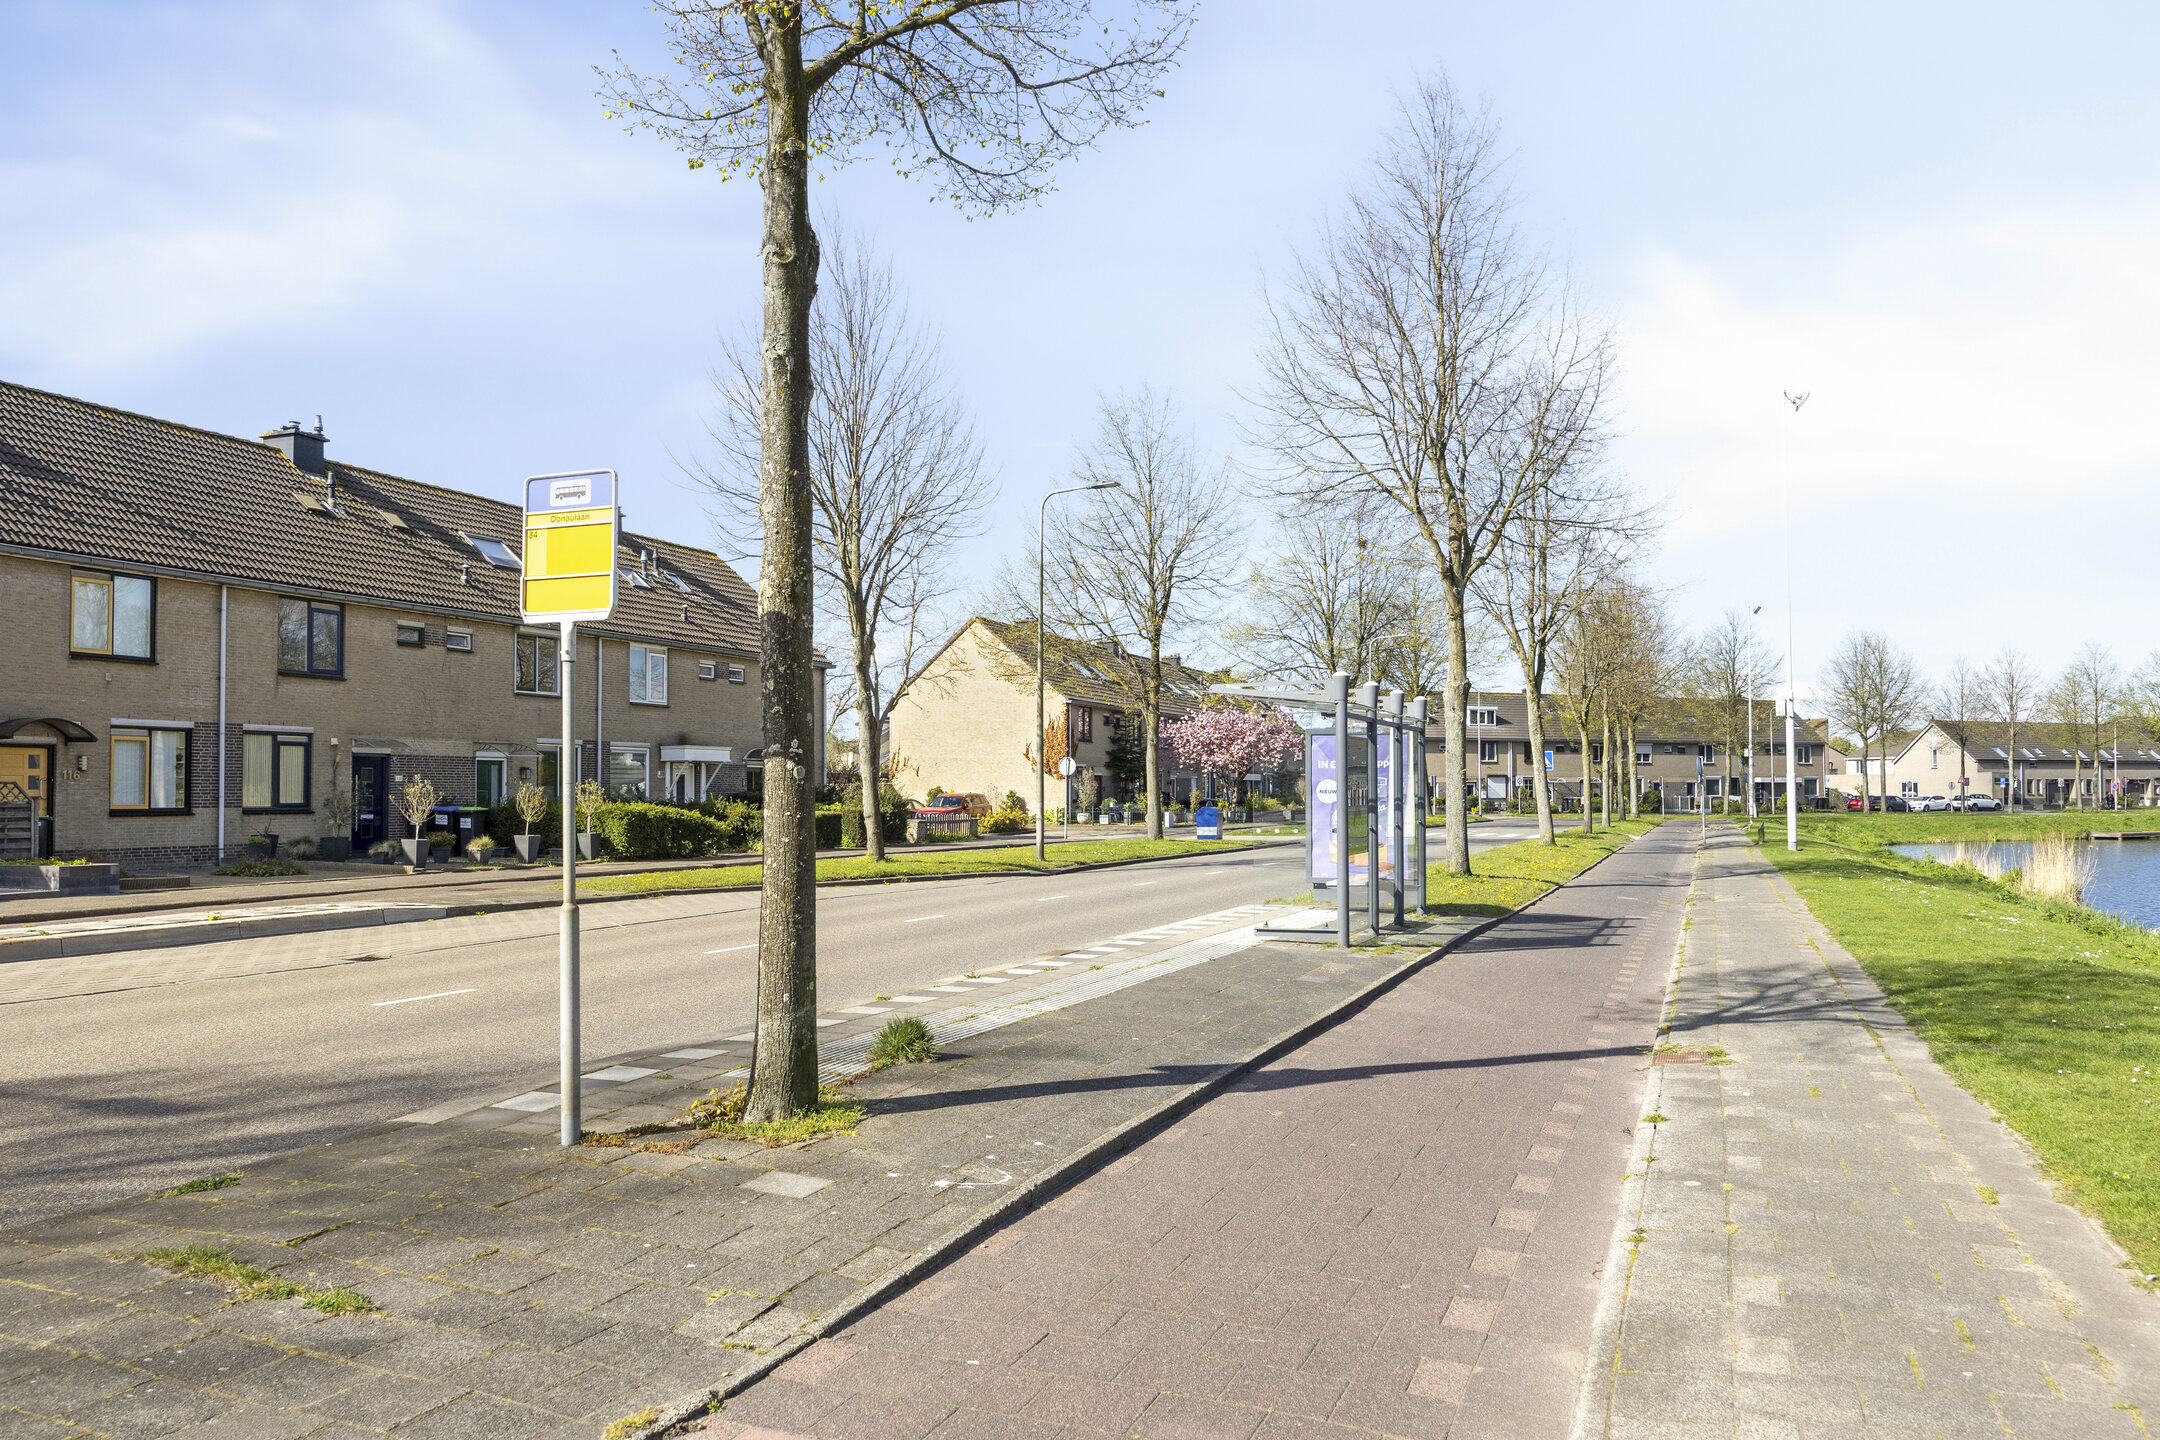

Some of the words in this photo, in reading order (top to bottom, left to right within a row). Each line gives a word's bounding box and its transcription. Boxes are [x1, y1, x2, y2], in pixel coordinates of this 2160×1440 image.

[550, 514, 590, 523] Donaulaan
[529, 531, 538, 539] 84
[1318, 760, 1329, 769] IN
[63, 770, 81, 780] 116
